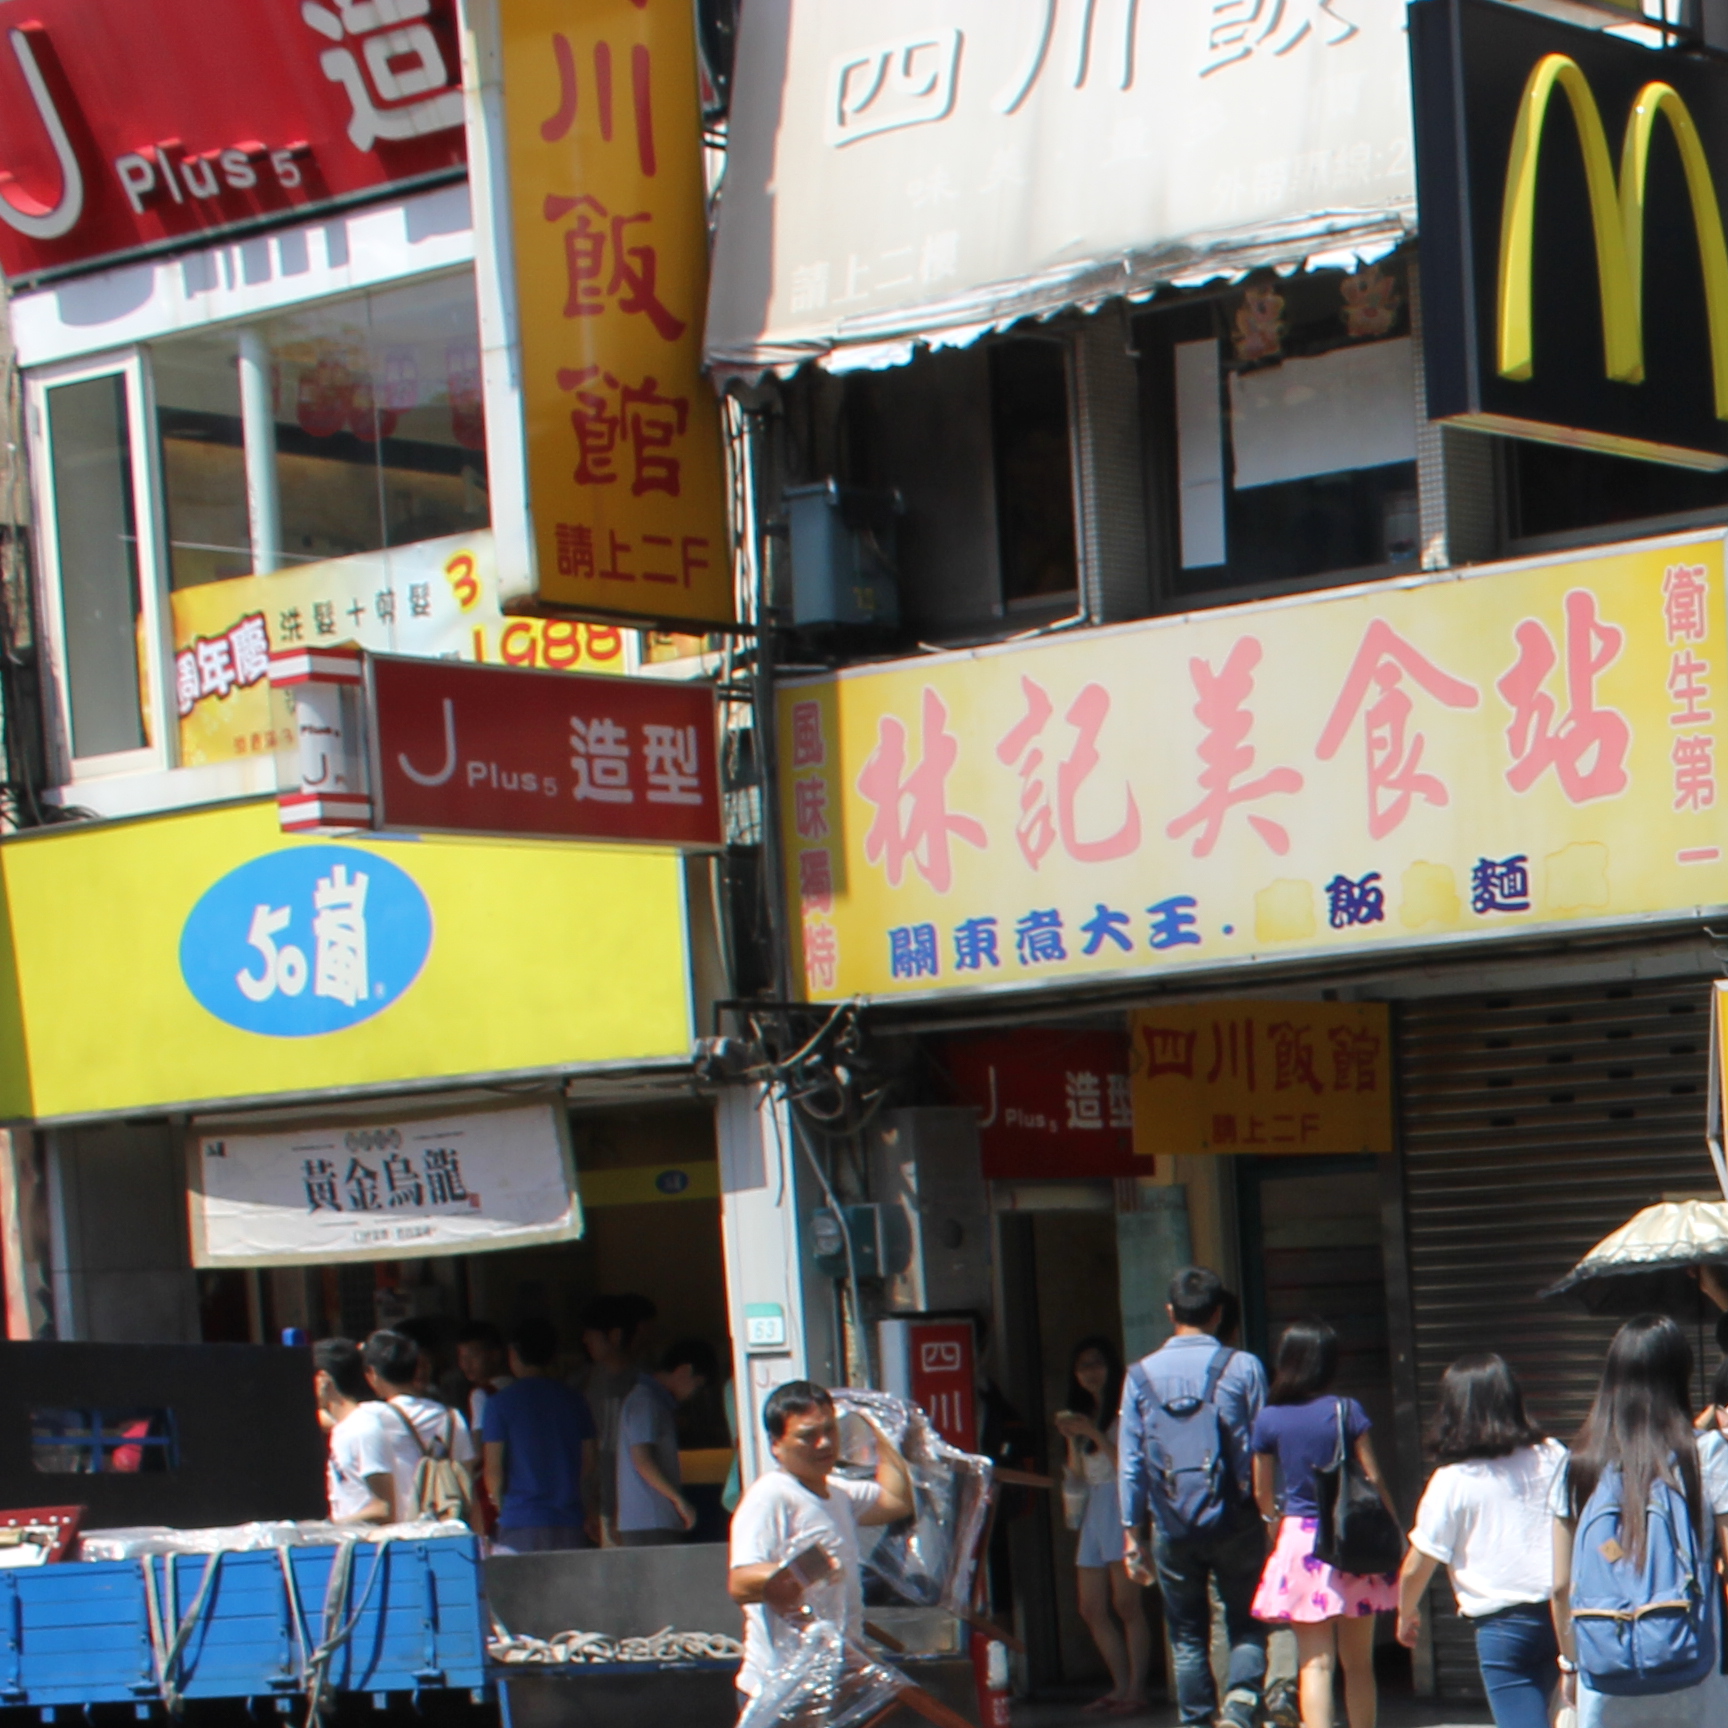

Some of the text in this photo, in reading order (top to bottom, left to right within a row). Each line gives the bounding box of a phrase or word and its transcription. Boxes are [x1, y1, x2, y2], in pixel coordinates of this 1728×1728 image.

[0, 21, 83, 239] J
[399, 698, 455, 787] J
[570, 716, 703, 806] 造型
[855, 588, 1631, 895] 林記美食站
[1661, 563, 1722, 866] 衛生第一
[236, 863, 370, 1007] 50嵐
[790, 700, 839, 992] 風味獨特
[1141, 1017, 1382, 1095] 四川飯館
[302, 1147, 471, 1216] 黃金烏龍
